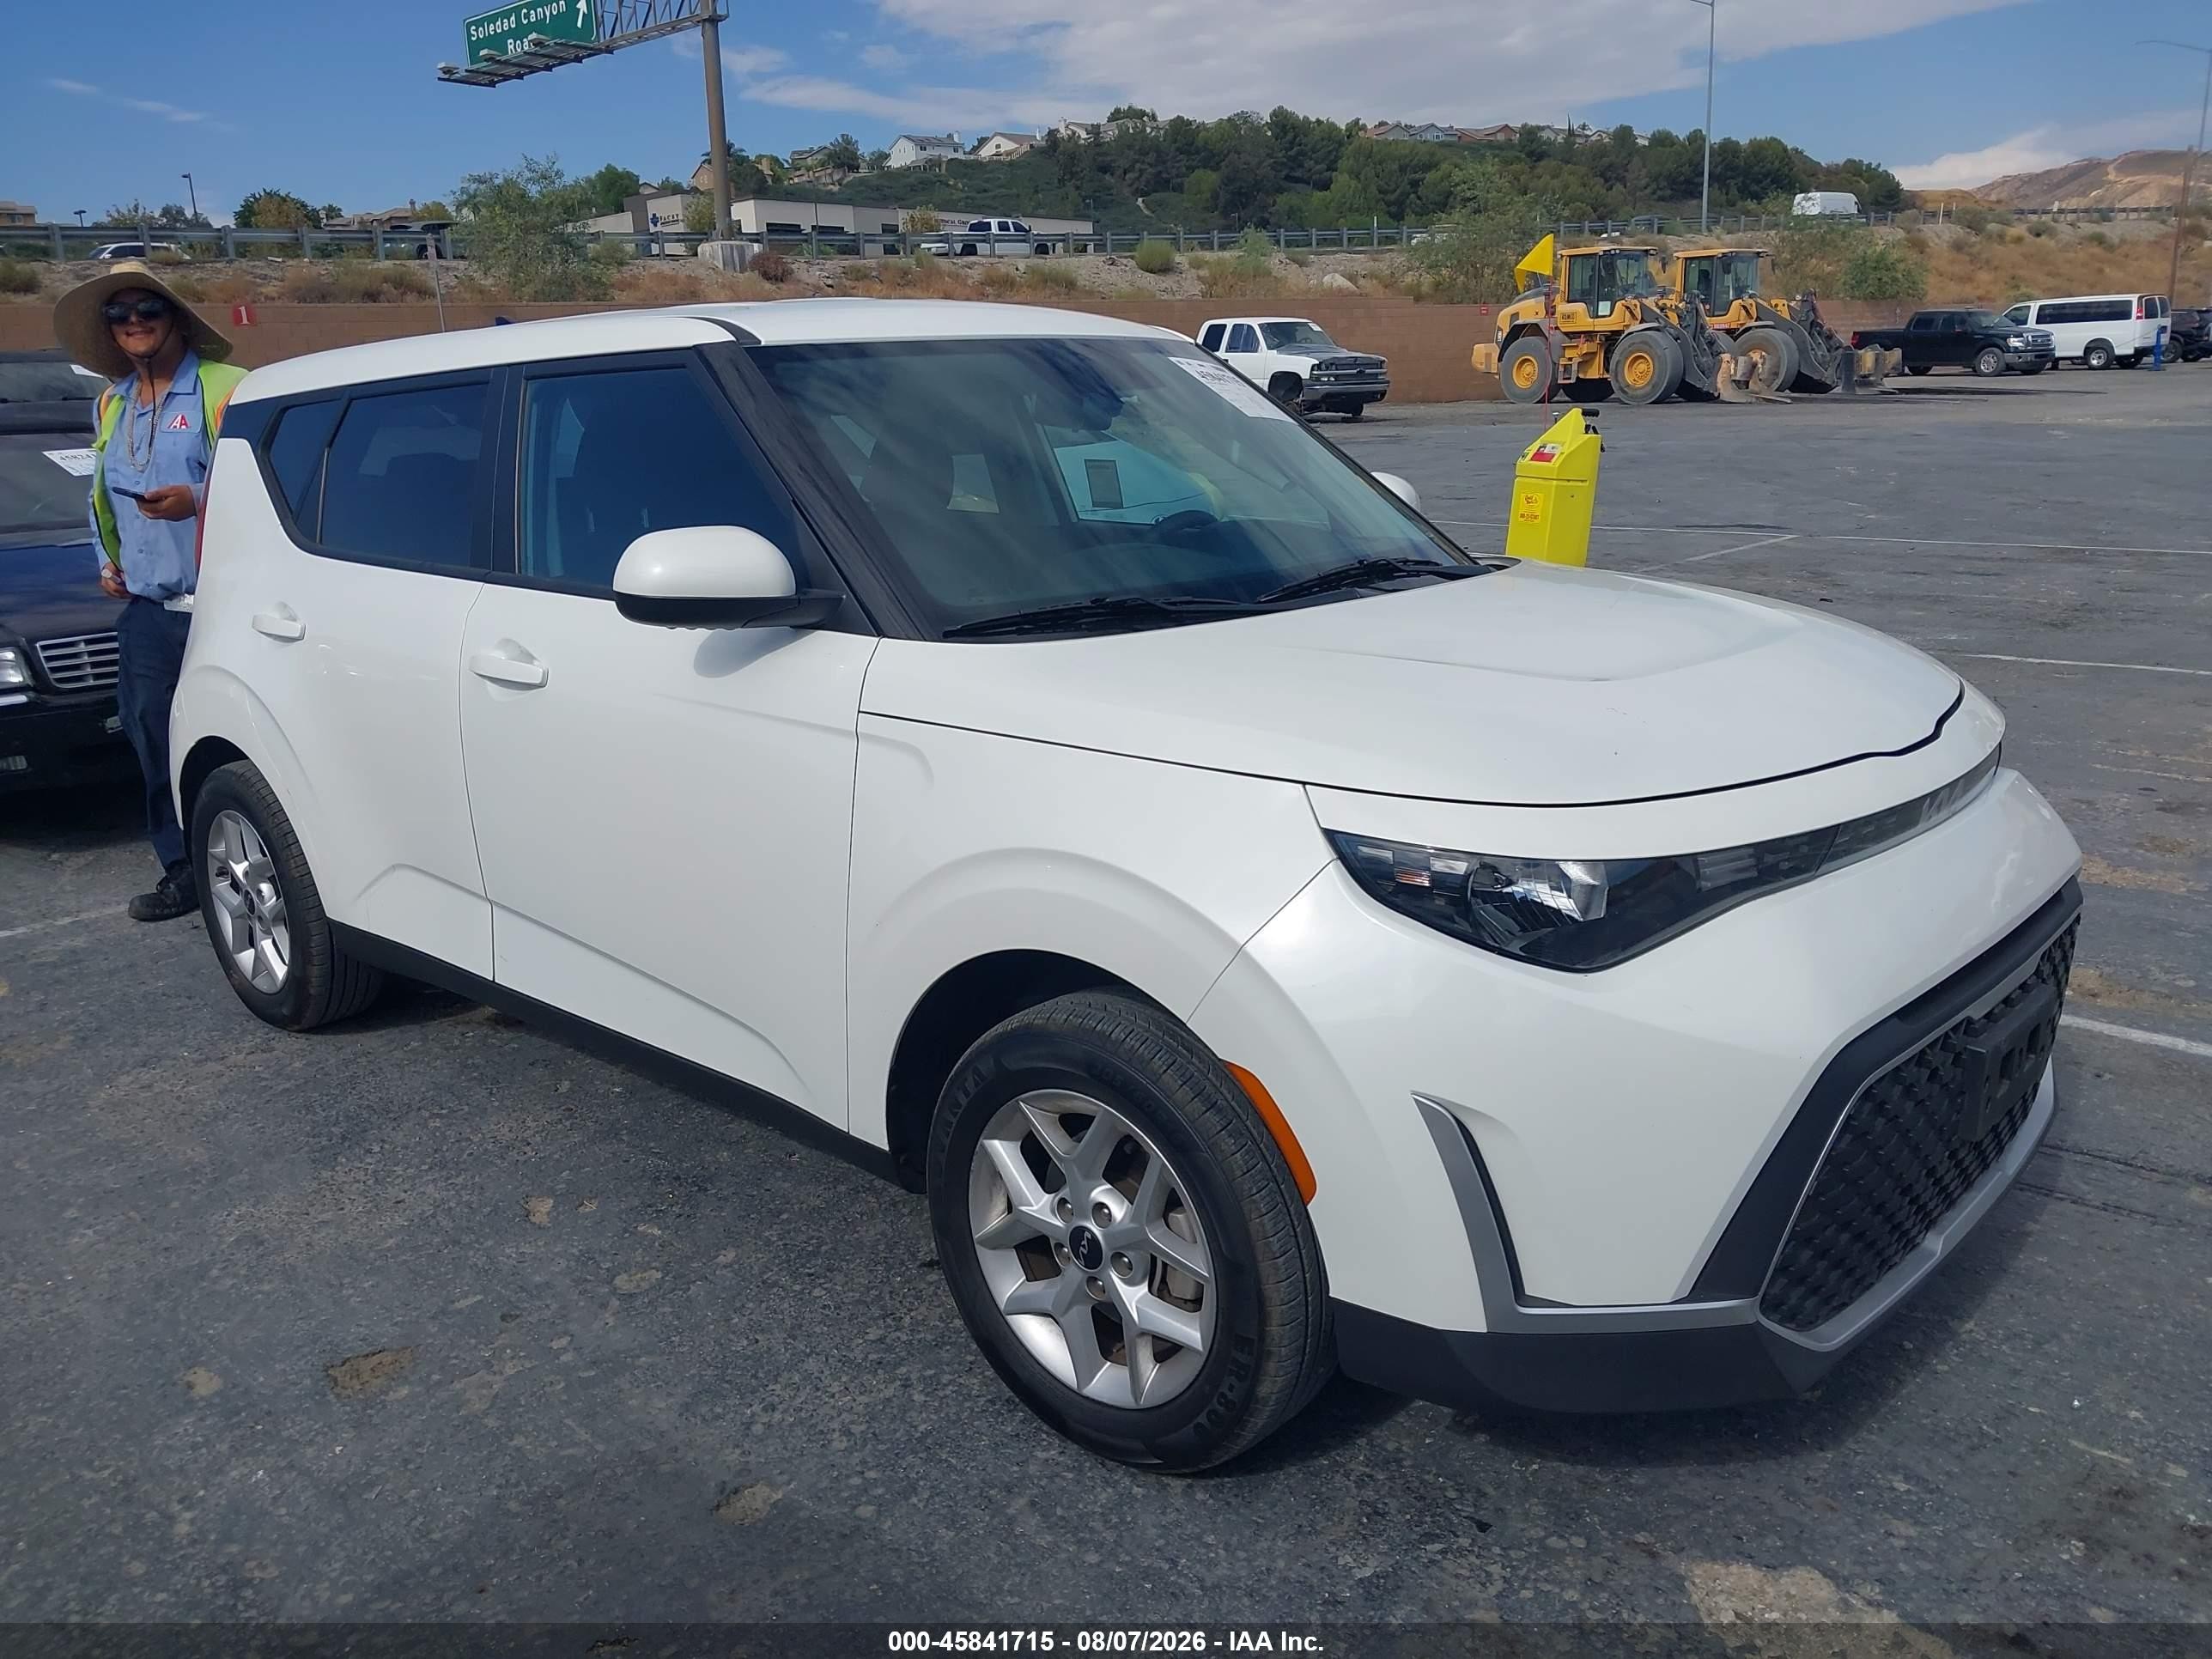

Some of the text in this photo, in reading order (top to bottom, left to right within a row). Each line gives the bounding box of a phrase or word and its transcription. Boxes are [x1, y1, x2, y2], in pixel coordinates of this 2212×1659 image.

[471, 0, 566, 41] Soledad Canyon
[507, 37, 536, 55] Roa
[239, 306, 250, 325] 1
